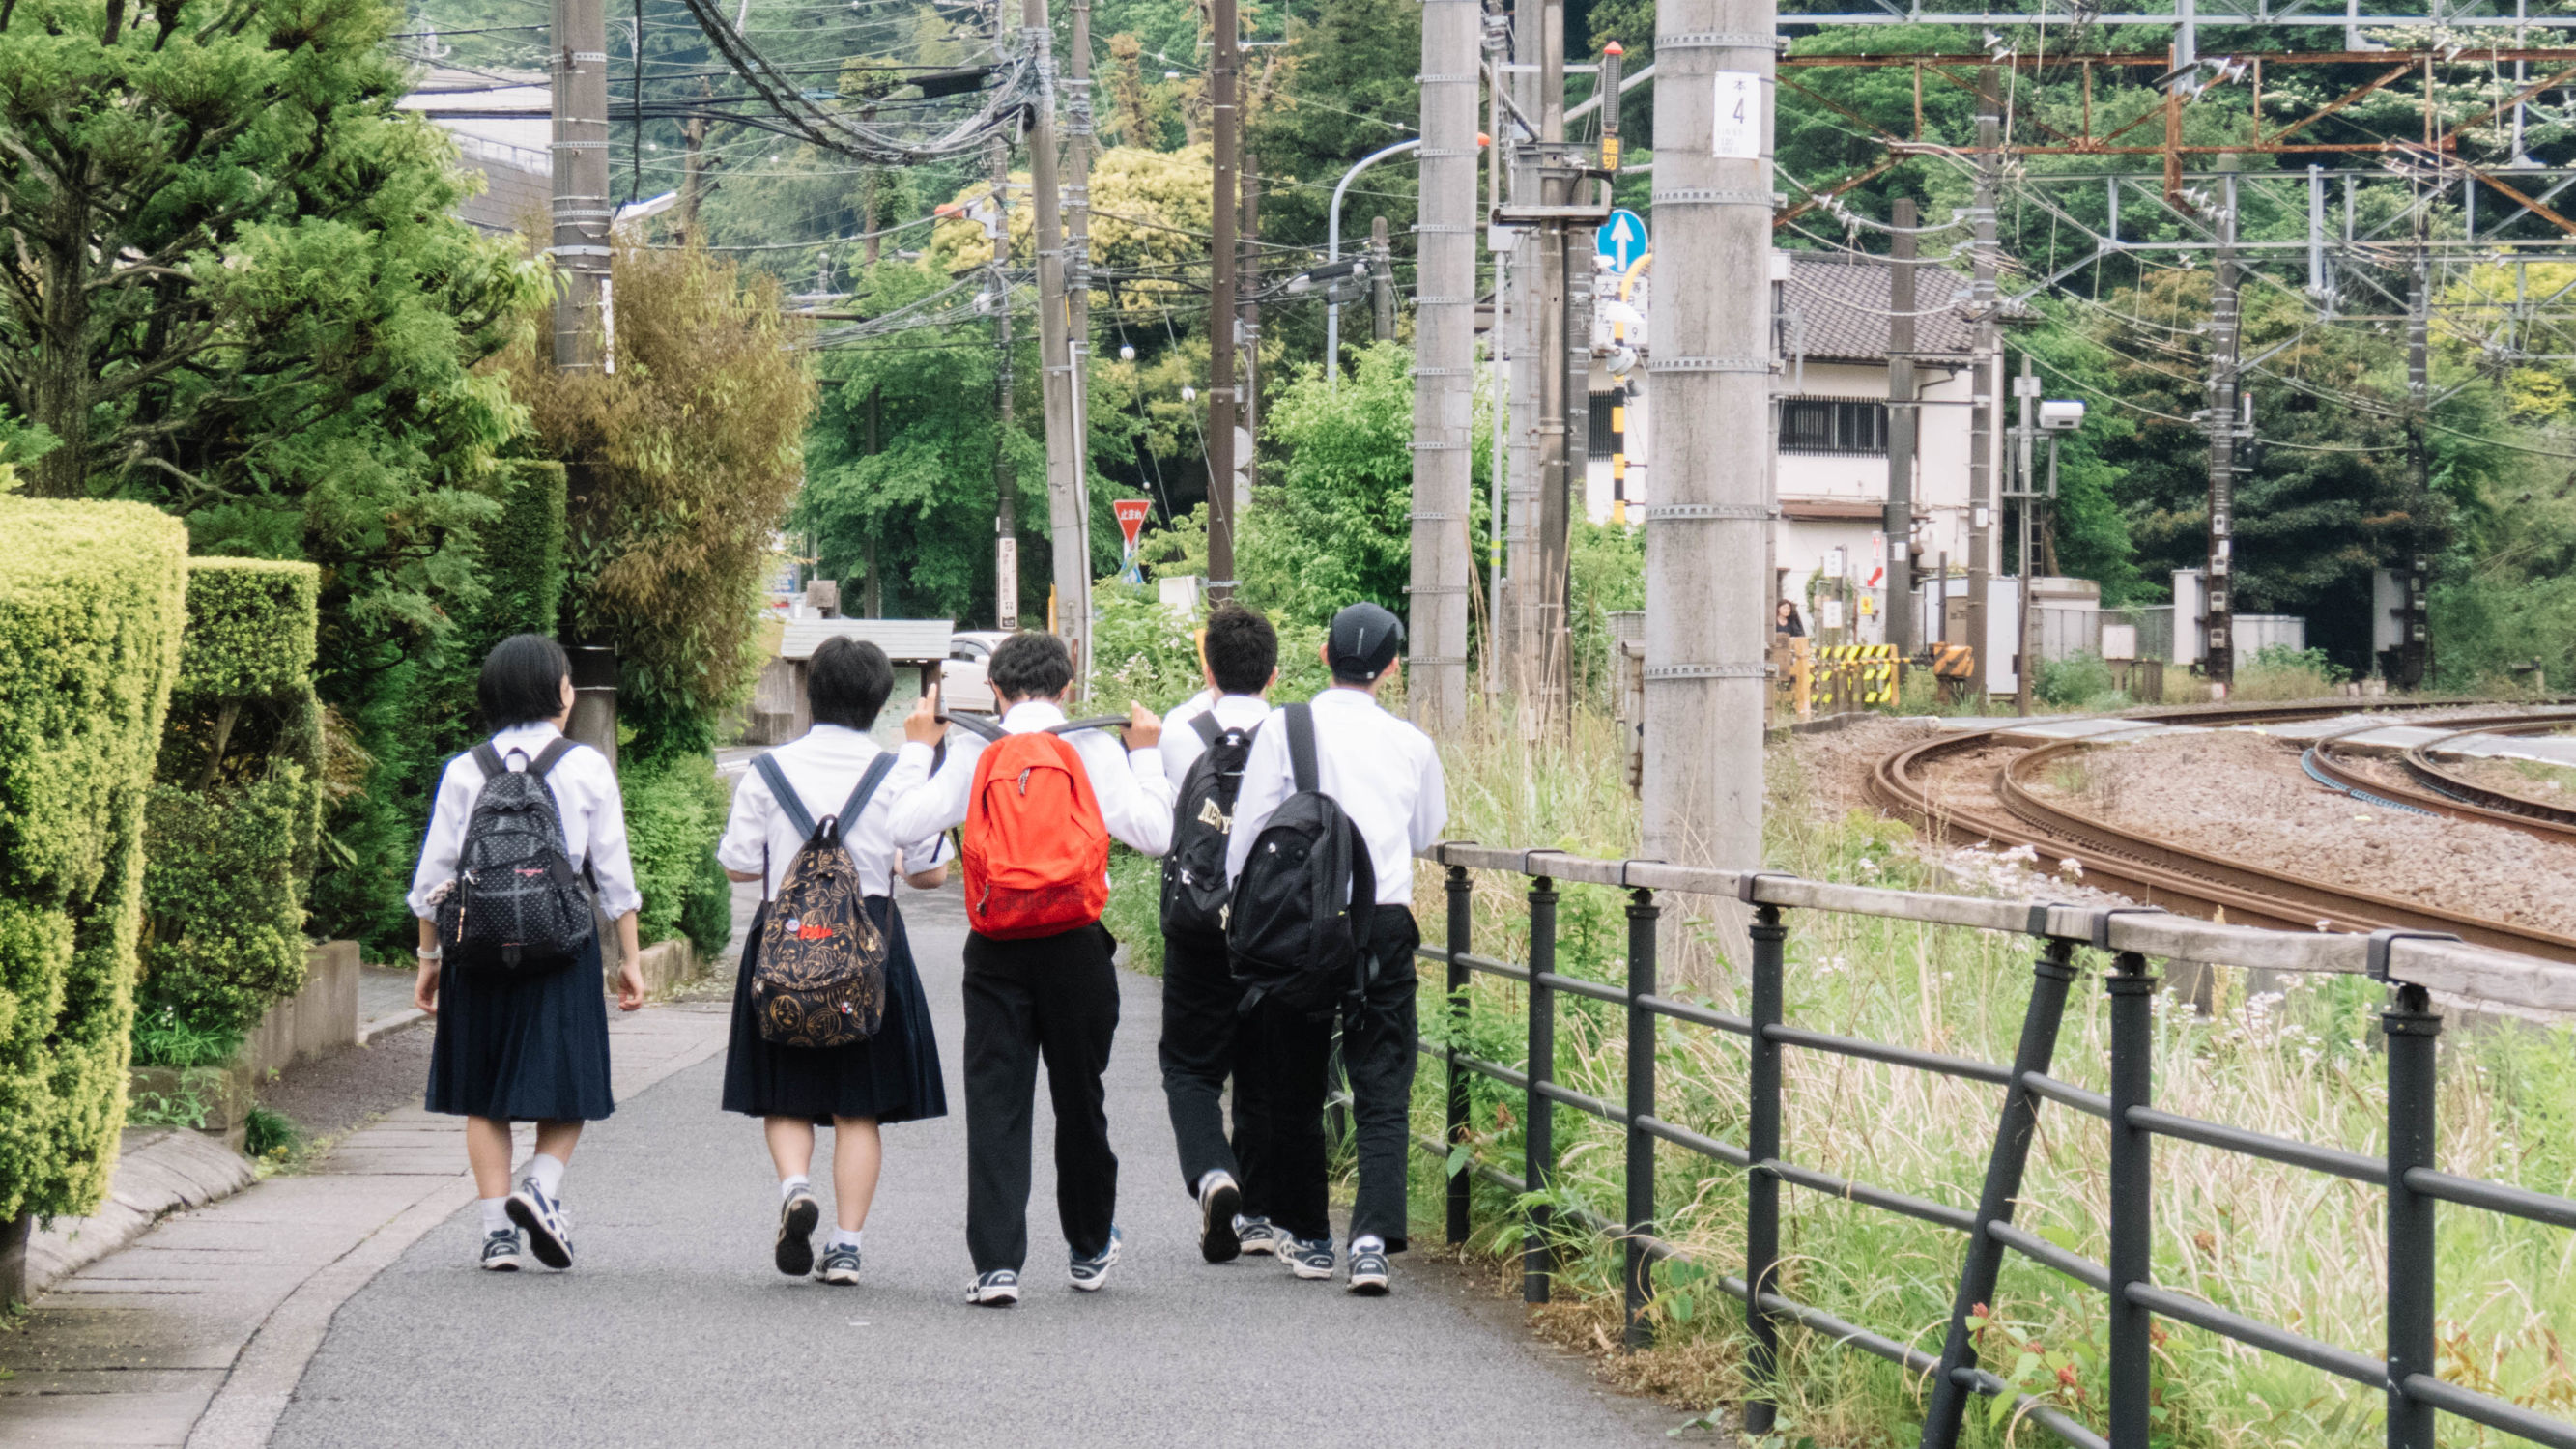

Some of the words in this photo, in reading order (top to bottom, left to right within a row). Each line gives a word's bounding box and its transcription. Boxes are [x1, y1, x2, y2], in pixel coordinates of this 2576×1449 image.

[1733, 98, 1745, 124] 4
[1602, 138, 1618, 170] 踏切
[1120, 509, 1141, 520] 止まれ
